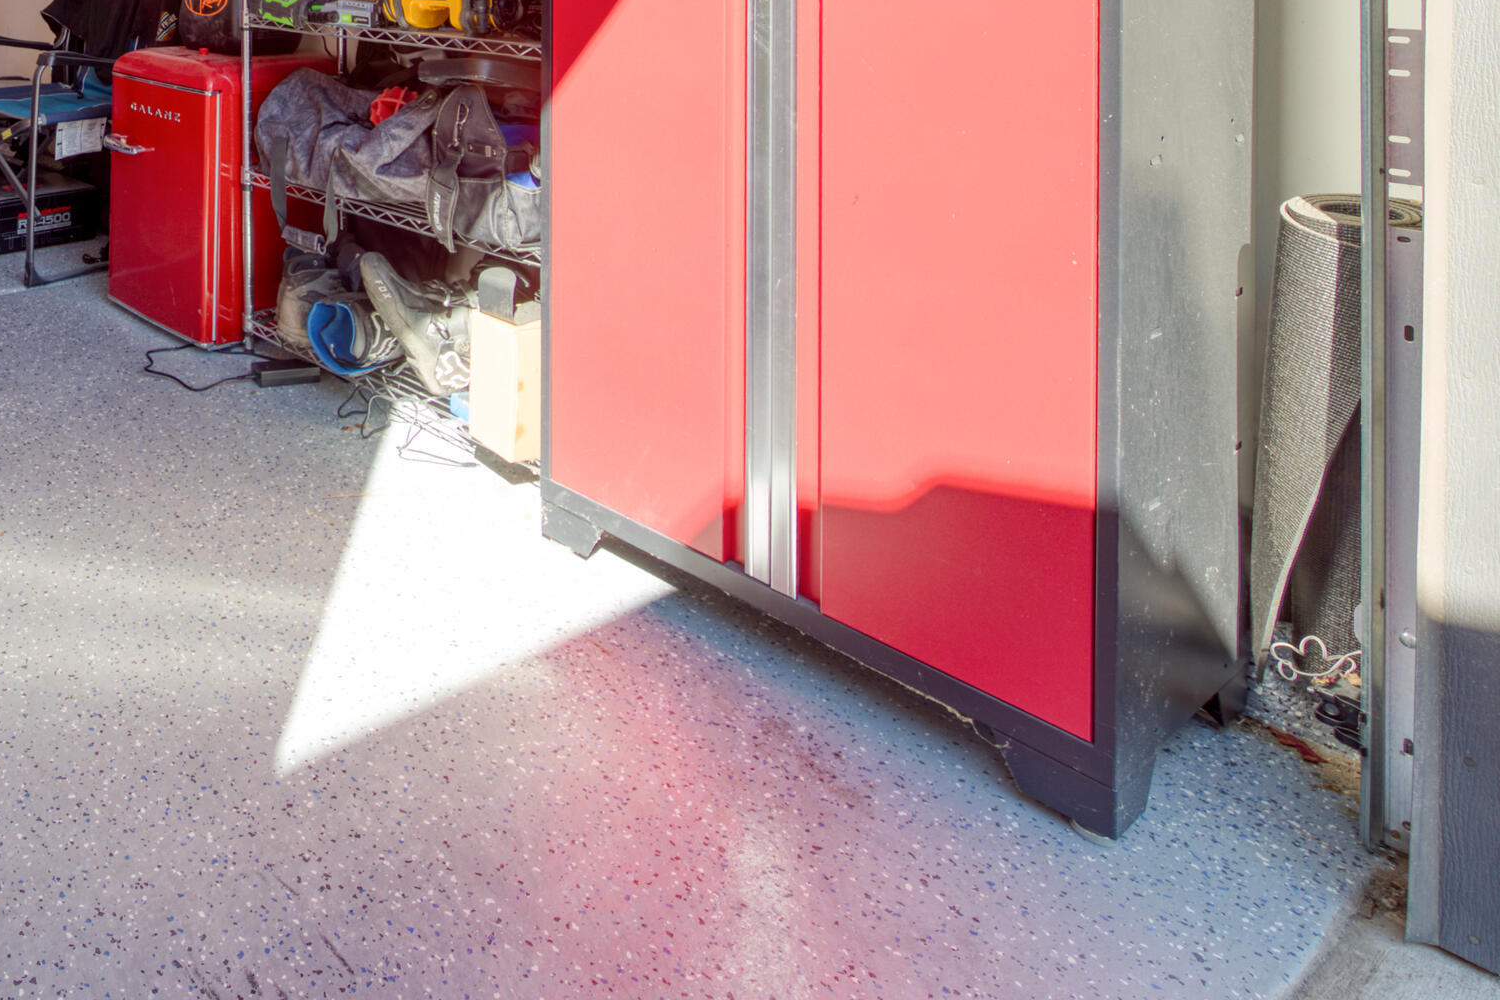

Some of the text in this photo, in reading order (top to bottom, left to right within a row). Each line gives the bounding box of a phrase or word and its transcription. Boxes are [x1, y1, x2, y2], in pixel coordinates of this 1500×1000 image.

[130, 101, 181, 123] GALANZ
[18, 212, 71, 230] R4500
[374, 280, 392, 299] FOX
